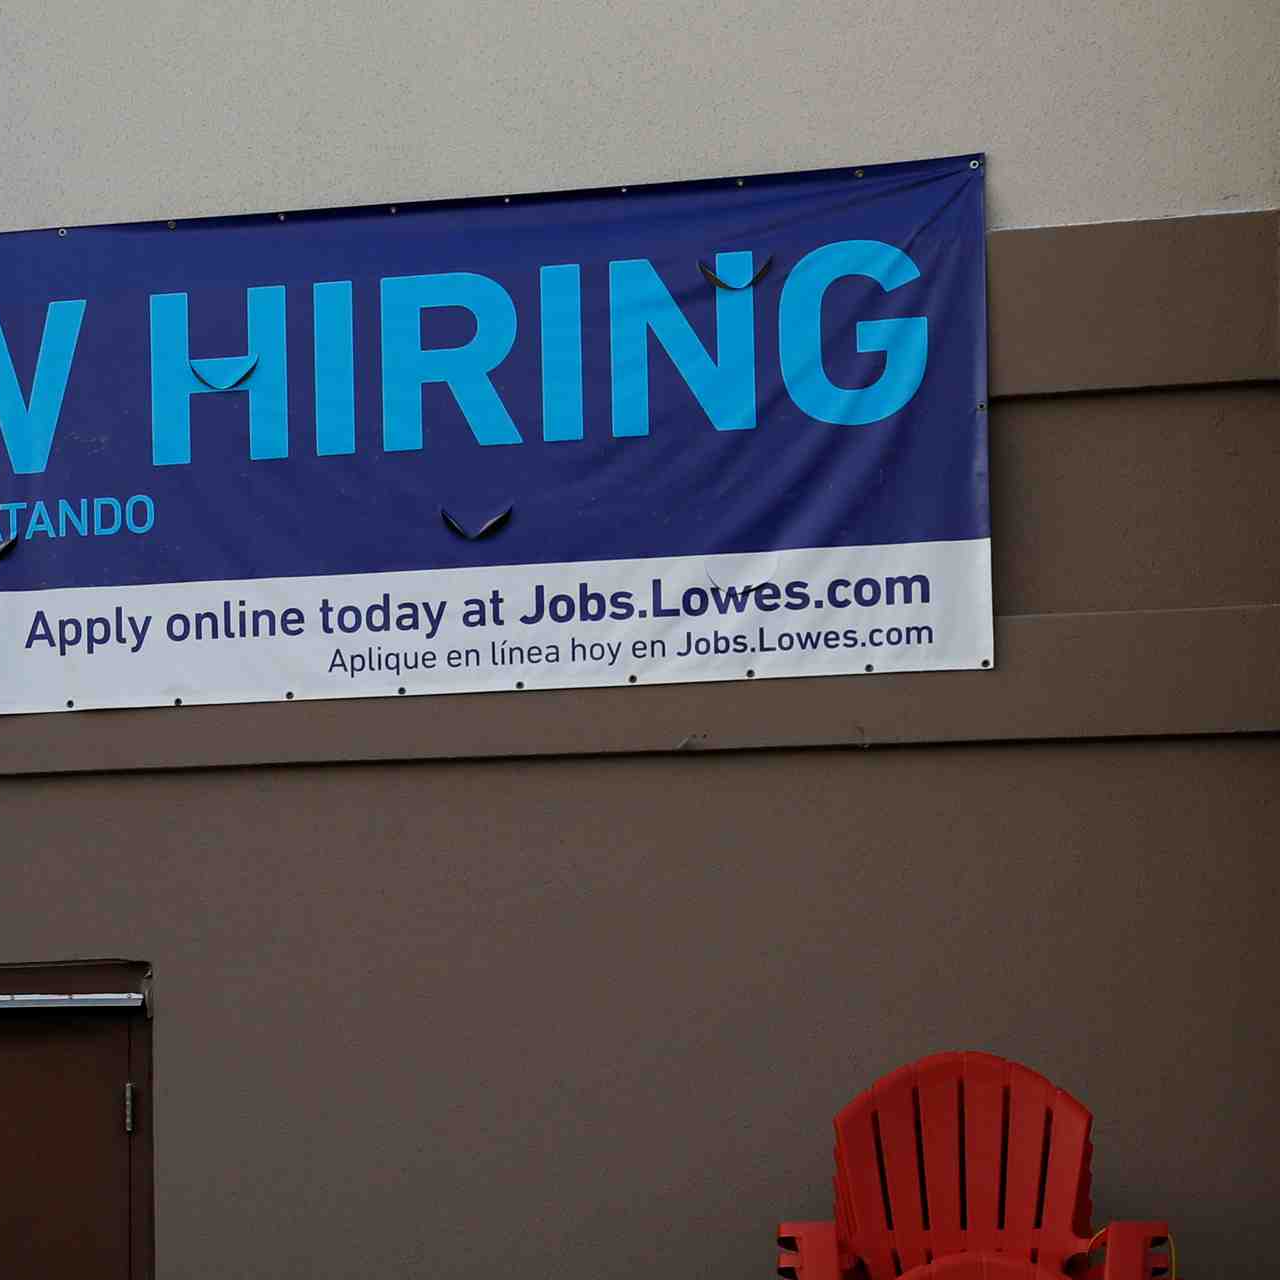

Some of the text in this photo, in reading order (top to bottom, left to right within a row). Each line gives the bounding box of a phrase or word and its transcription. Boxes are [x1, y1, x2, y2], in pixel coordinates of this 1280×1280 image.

[149, 239, 928, 466] HIRING
[25, 573, 931, 656] Apply online today at Jobs.Lowes.com
[329, 625, 934, 678] Aplique en línea hoy en Jobs.Lowes.com
